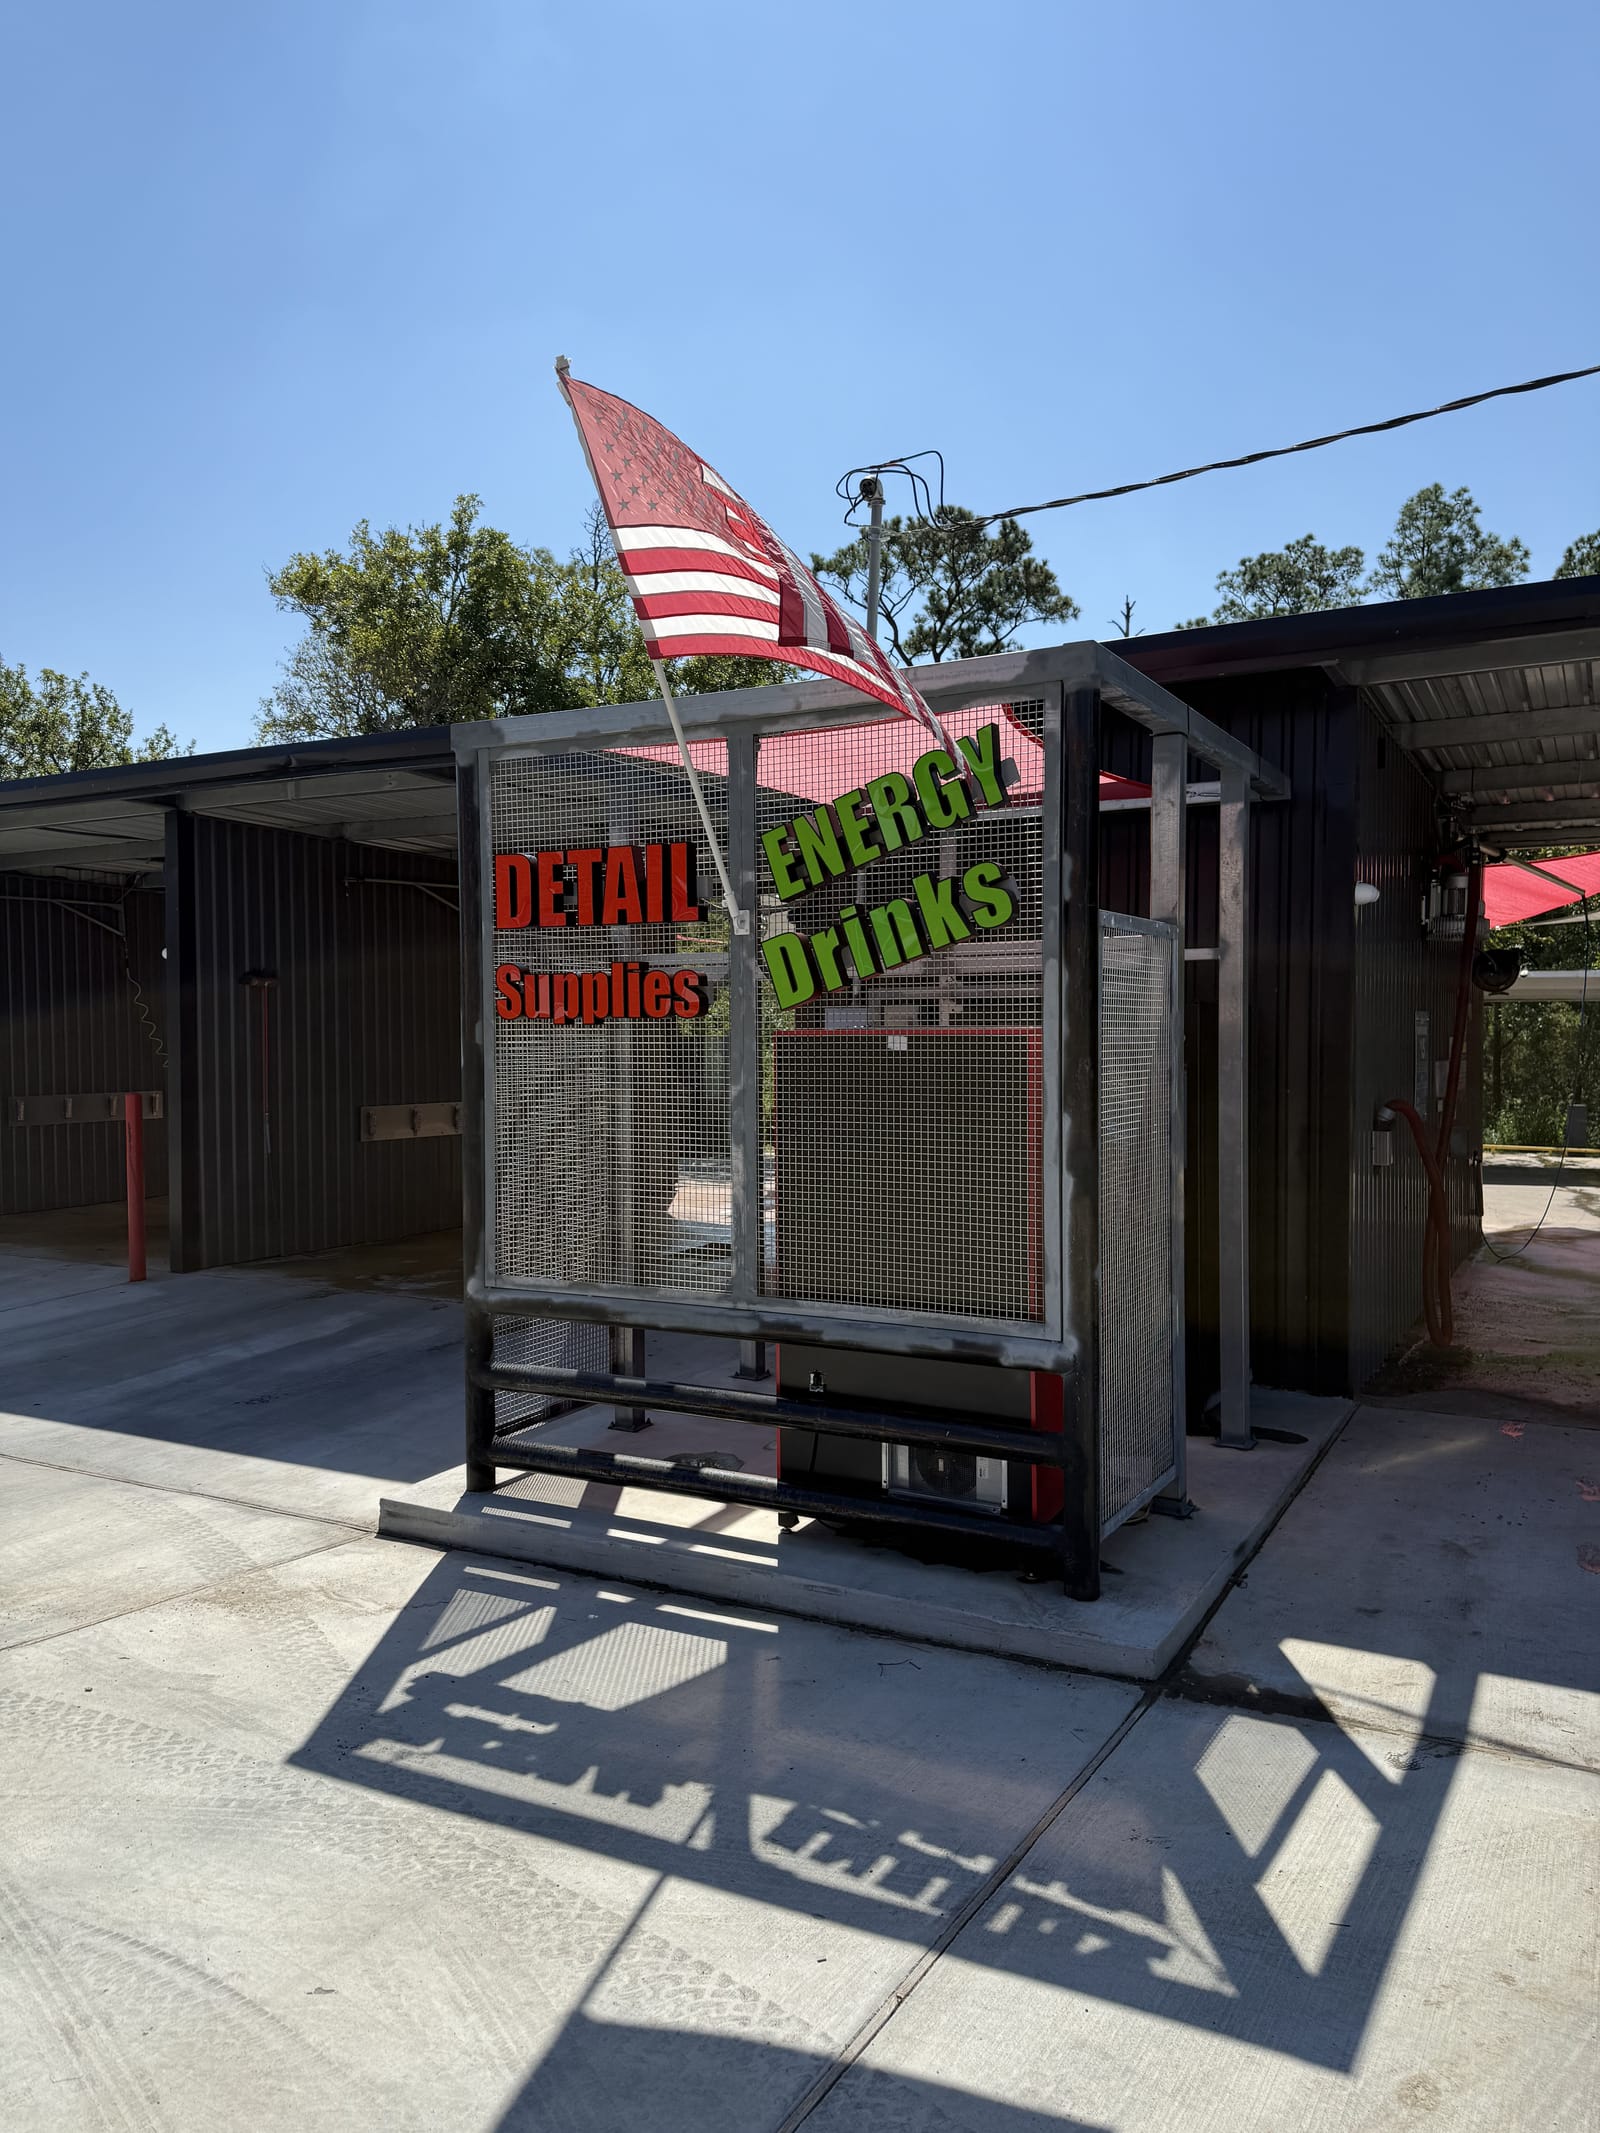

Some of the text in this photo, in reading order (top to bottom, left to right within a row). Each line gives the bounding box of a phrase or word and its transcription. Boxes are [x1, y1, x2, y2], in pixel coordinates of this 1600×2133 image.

[760, 722, 1005, 901] ENERGY
[495, 842, 700, 929] DETAIL
[760, 861, 1013, 1010] Drinks
[495, 962, 701, 1026] Supplies
